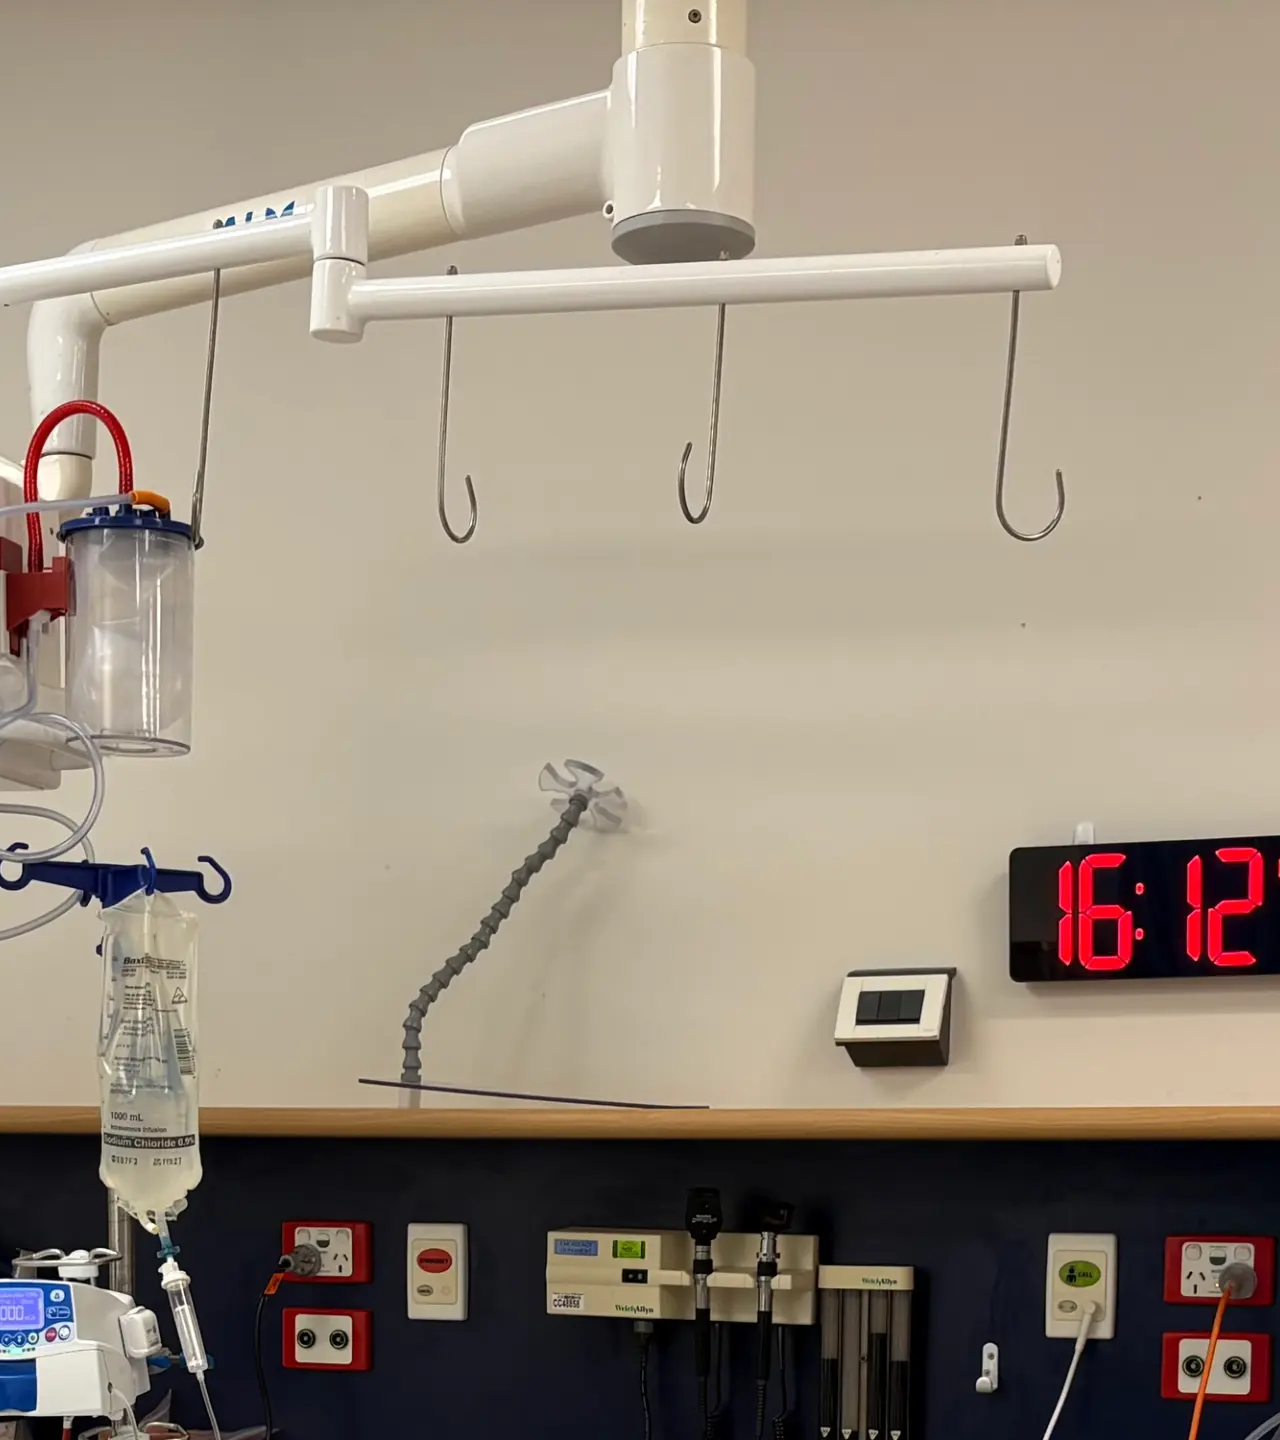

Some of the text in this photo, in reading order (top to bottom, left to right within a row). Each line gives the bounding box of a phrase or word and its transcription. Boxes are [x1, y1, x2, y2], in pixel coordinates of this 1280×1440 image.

[1057, 846, 1265, 972] 16:12
[110, 1111, 144, 1122] 1000 mL
[134, 1138, 176, 1148] Chloride
[1077, 1271, 1093, 1280] CALL
